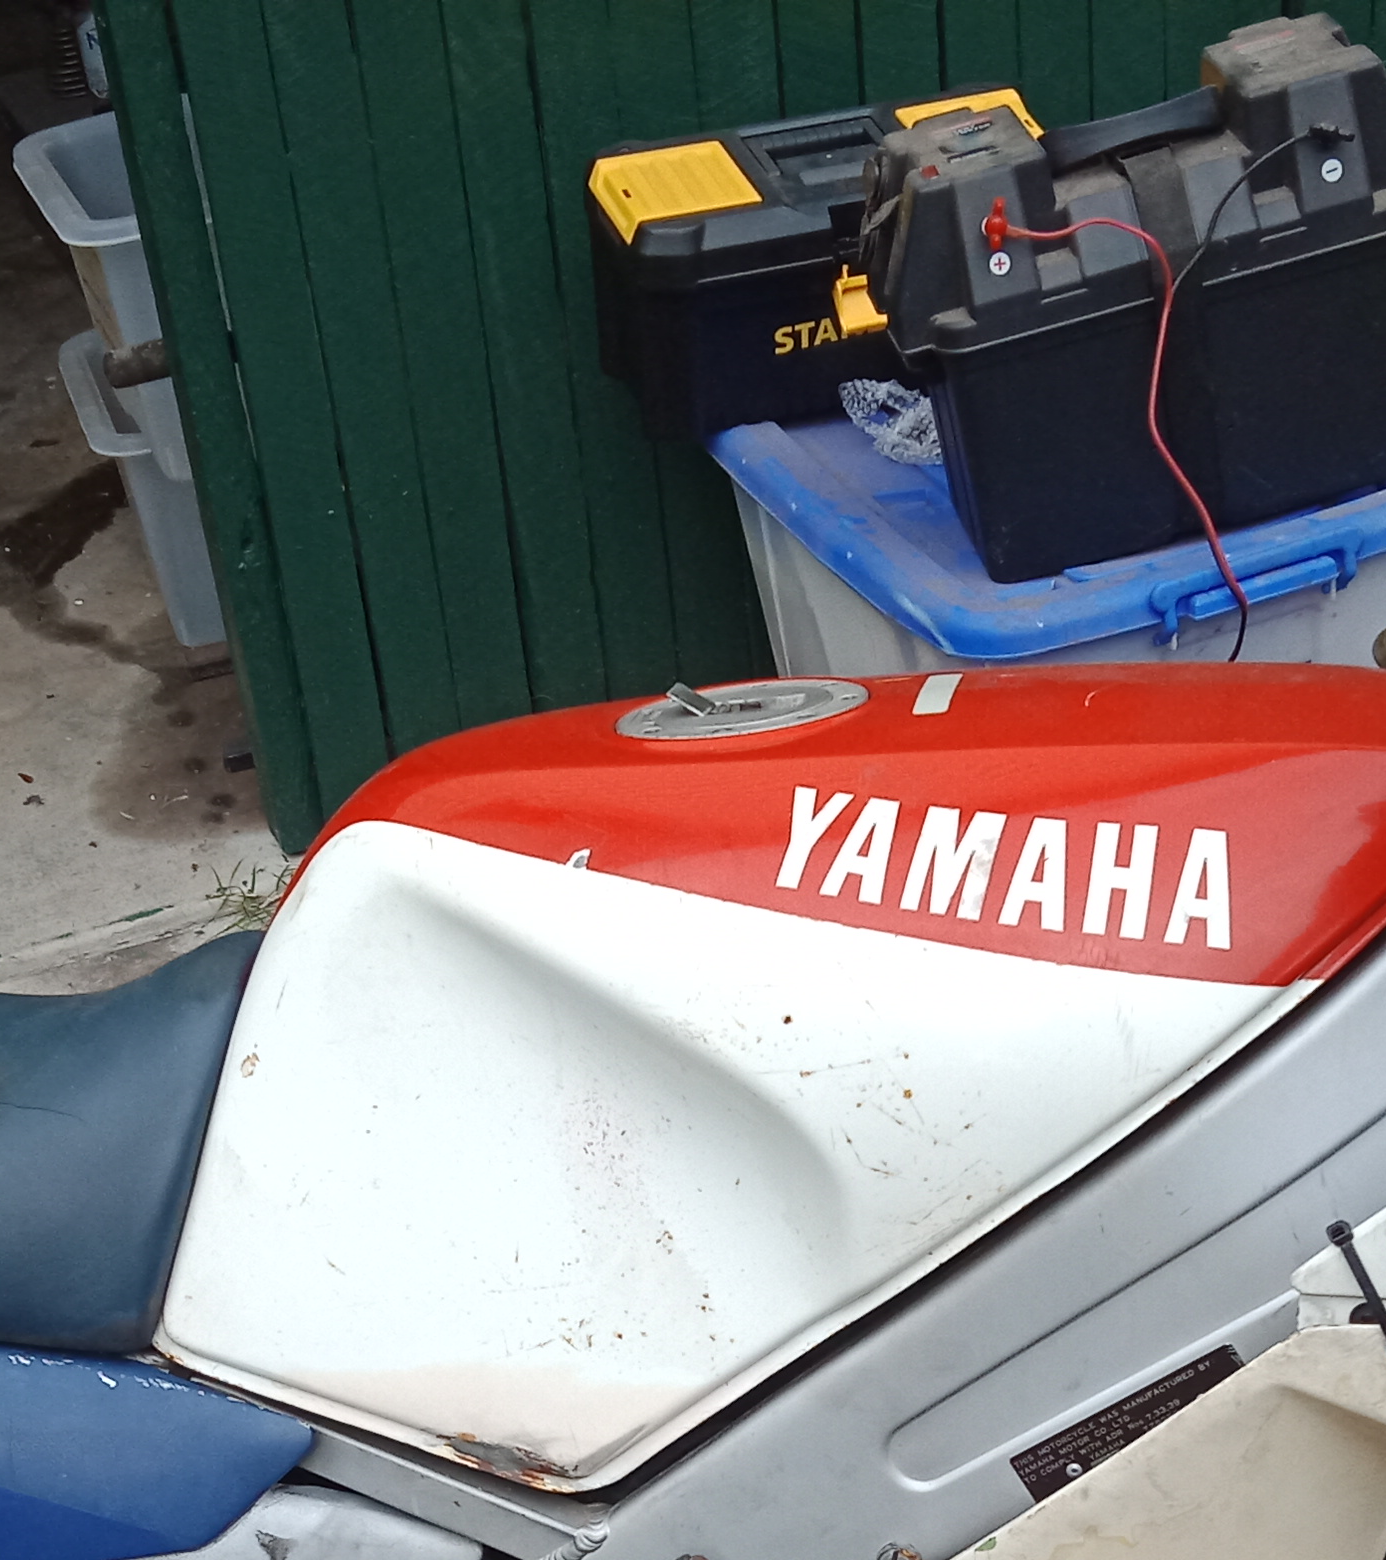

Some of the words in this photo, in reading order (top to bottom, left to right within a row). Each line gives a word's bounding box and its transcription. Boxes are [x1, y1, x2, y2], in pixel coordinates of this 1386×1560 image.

[774, 317, 849, 355] STA
[775, 785, 1233, 950] YAMAHA
[1013, 1454, 1034, 1468] THIS
[1037, 1421, 1096, 1456] MOTORCYCLE
[1099, 1409, 1119, 1423] WAS
[1121, 1369, 1194, 1411] MANUFACTURED
[1197, 1360, 1210, 1371] BY
[1018, 1454, 1055, 1476] YAMAHA
[1058, 1435, 1090, 1455] MOTOR
[1024, 1474, 1037, 1484] TO
[1040, 1453, 1075, 1476] COMPLY
[1078, 1440, 1102, 1455] WITH
[1105, 1428, 1124, 1442] ADR
[1089, 1439, 1125, 1461] YAMAHA
